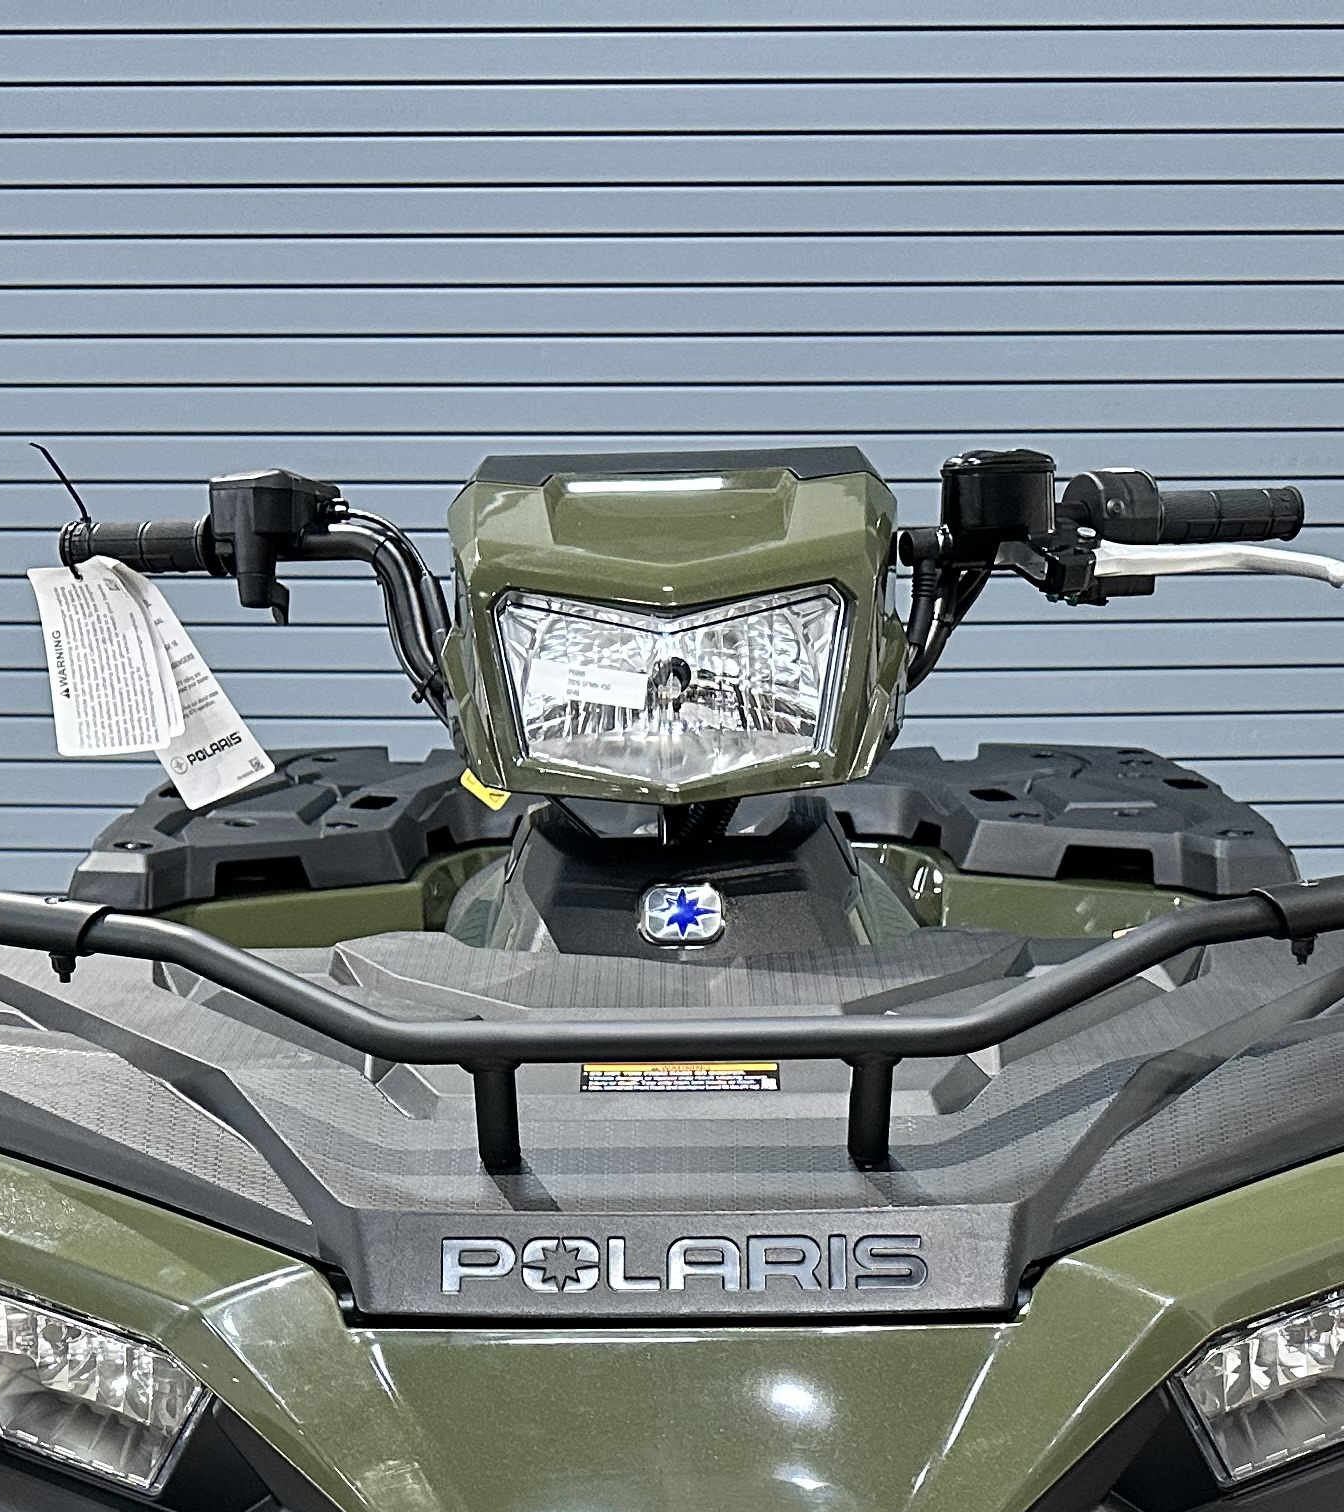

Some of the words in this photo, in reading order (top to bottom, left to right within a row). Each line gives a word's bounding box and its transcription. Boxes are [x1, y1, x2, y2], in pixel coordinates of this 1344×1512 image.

[51, 629, 69, 687] WARNING
[186, 730, 242, 765] POLARIS
[440, 1233, 930, 1295] POLARIS
